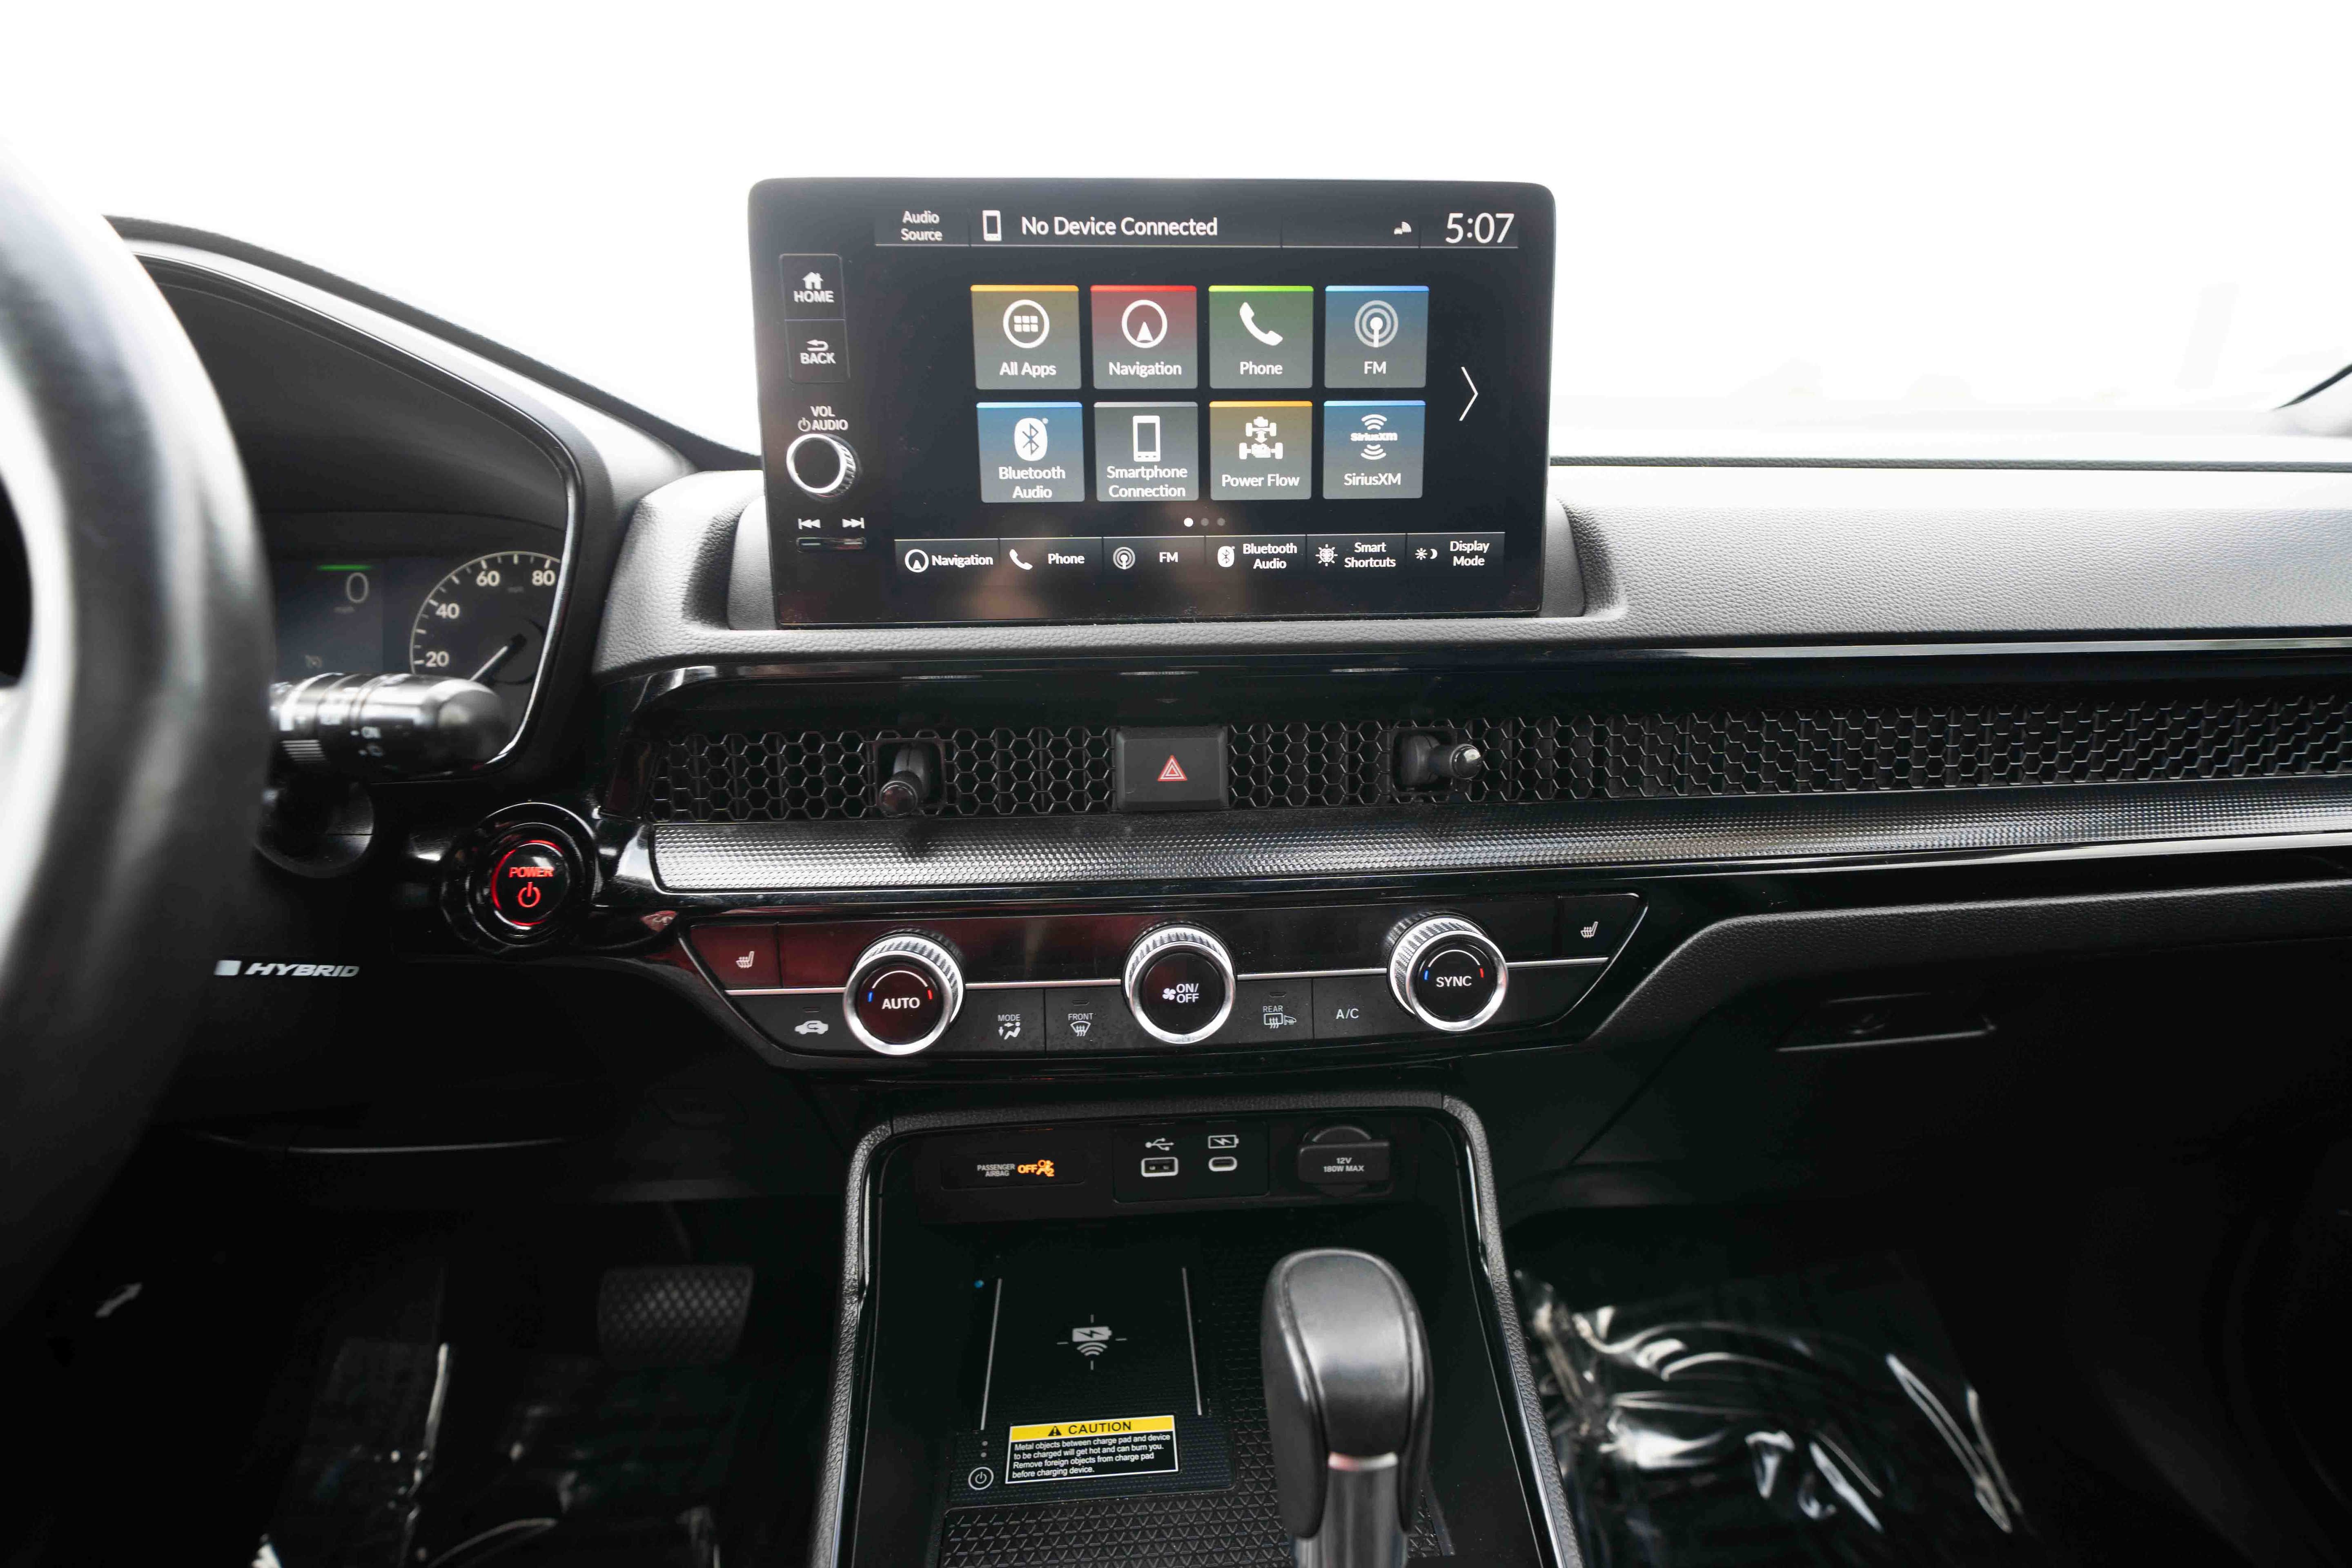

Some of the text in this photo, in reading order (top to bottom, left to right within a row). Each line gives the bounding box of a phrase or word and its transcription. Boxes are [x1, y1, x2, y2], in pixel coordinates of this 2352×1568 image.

[902, 210, 940, 224] Audio
[1022, 216, 1218, 236] No Device Connected
[1446, 212, 1515, 243] 5:07
[901, 228, 942, 241] Source
[793, 290, 834, 303] HOME
[800, 352, 836, 364] BACK
[999, 361, 1056, 378] All Apps
[1109, 361, 1182, 378] Navigation
[1240, 361, 1283, 375] Phone
[1364, 361, 1386, 374] FM
[810, 405, 835, 417] VOL
[811, 419, 849, 431] AUDIO
[998, 466, 1066, 480] Bluetooth
[1107, 465, 1188, 481] Smartphone
[1344, 472, 1401, 486] SiriusXM
[1222, 473, 1300, 487] Power Flow
[1012, 485, 1053, 499] Audio
[1109, 484, 1186, 498] Connection
[1243, 542, 1297, 554] Bluetooth
[1354, 542, 1387, 553] Smart
[1450, 540, 1490, 553] Display
[931, 554, 993, 568] Navigation
[1048, 553, 1085, 564] Phone
[1159, 552, 1178, 563] FM
[1253, 558, 1287, 569] Audio
[1344, 557, 1396, 568] Shortcuts
[1453, 555, 1485, 566] Mode
[476, 570, 500, 586] 60
[532, 570, 556, 586] 80
[346, 572, 369, 604] 0
[435, 603, 460, 619] 40
[425, 651, 449, 667] 20
[509, 866, 554, 878] POWER
[245, 962, 359, 977] HYBRID
[1176, 983, 1199, 993] ON/
[1436, 976, 1472, 987] SYNC
[882, 997, 920, 1009] AUTO
[1176, 993, 1199, 1003] OFF
[1336, 1008, 1359, 1019] A/C
[1017, 1164, 1038, 1174] OFF
[1068, 1421, 1131, 1434] CAUTION
[1036, 1442, 1061, 1450] objects
[1093, 1437, 1117, 1446] charge
[1118, 1436, 1131, 1444] pad
[1033, 1450, 1062, 1458] charged
[1149, 1443, 1164, 1452] you.
[1070, 1457, 1096, 1466] objects
[1140, 1452, 1155, 1461] pad
[1037, 1468, 1067, 1477] charging
